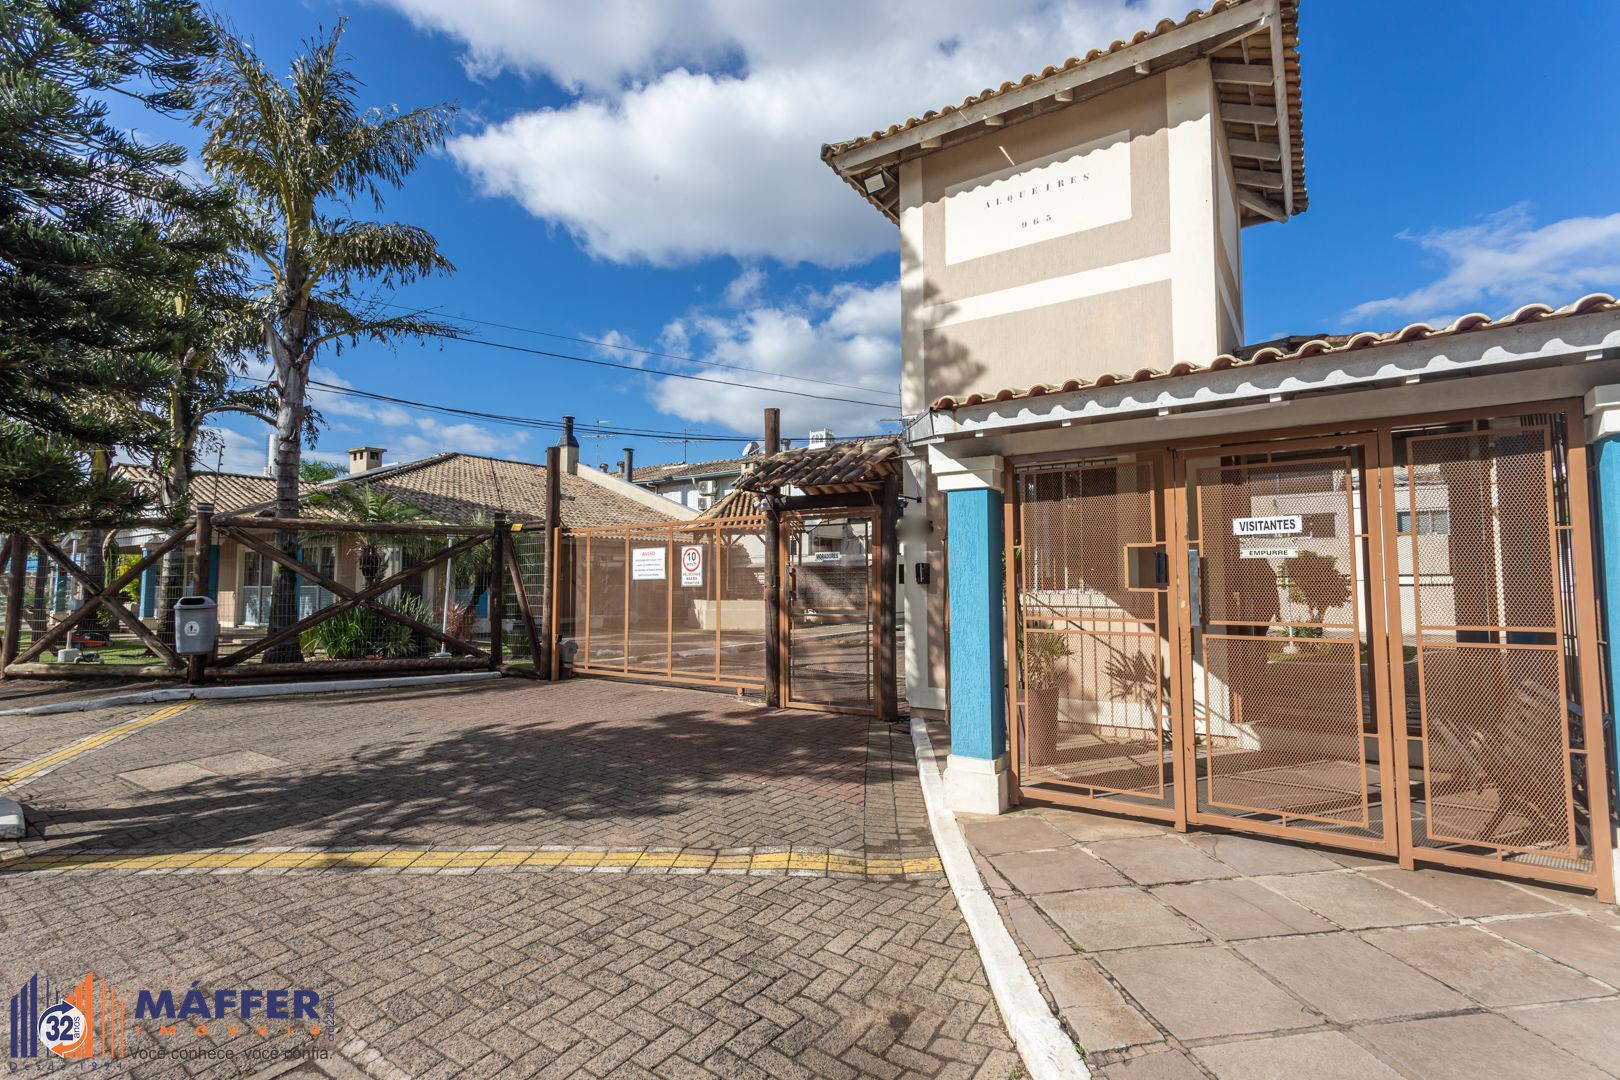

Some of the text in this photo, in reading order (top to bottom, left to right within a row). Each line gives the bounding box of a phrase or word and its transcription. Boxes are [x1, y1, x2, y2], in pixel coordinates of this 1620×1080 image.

[984, 172, 1090, 209] ALQUEIRES
[1021, 214, 1052, 229] 965
[1239, 519, 1296, 532] VISITANTES
[687, 552, 696, 561] 10
